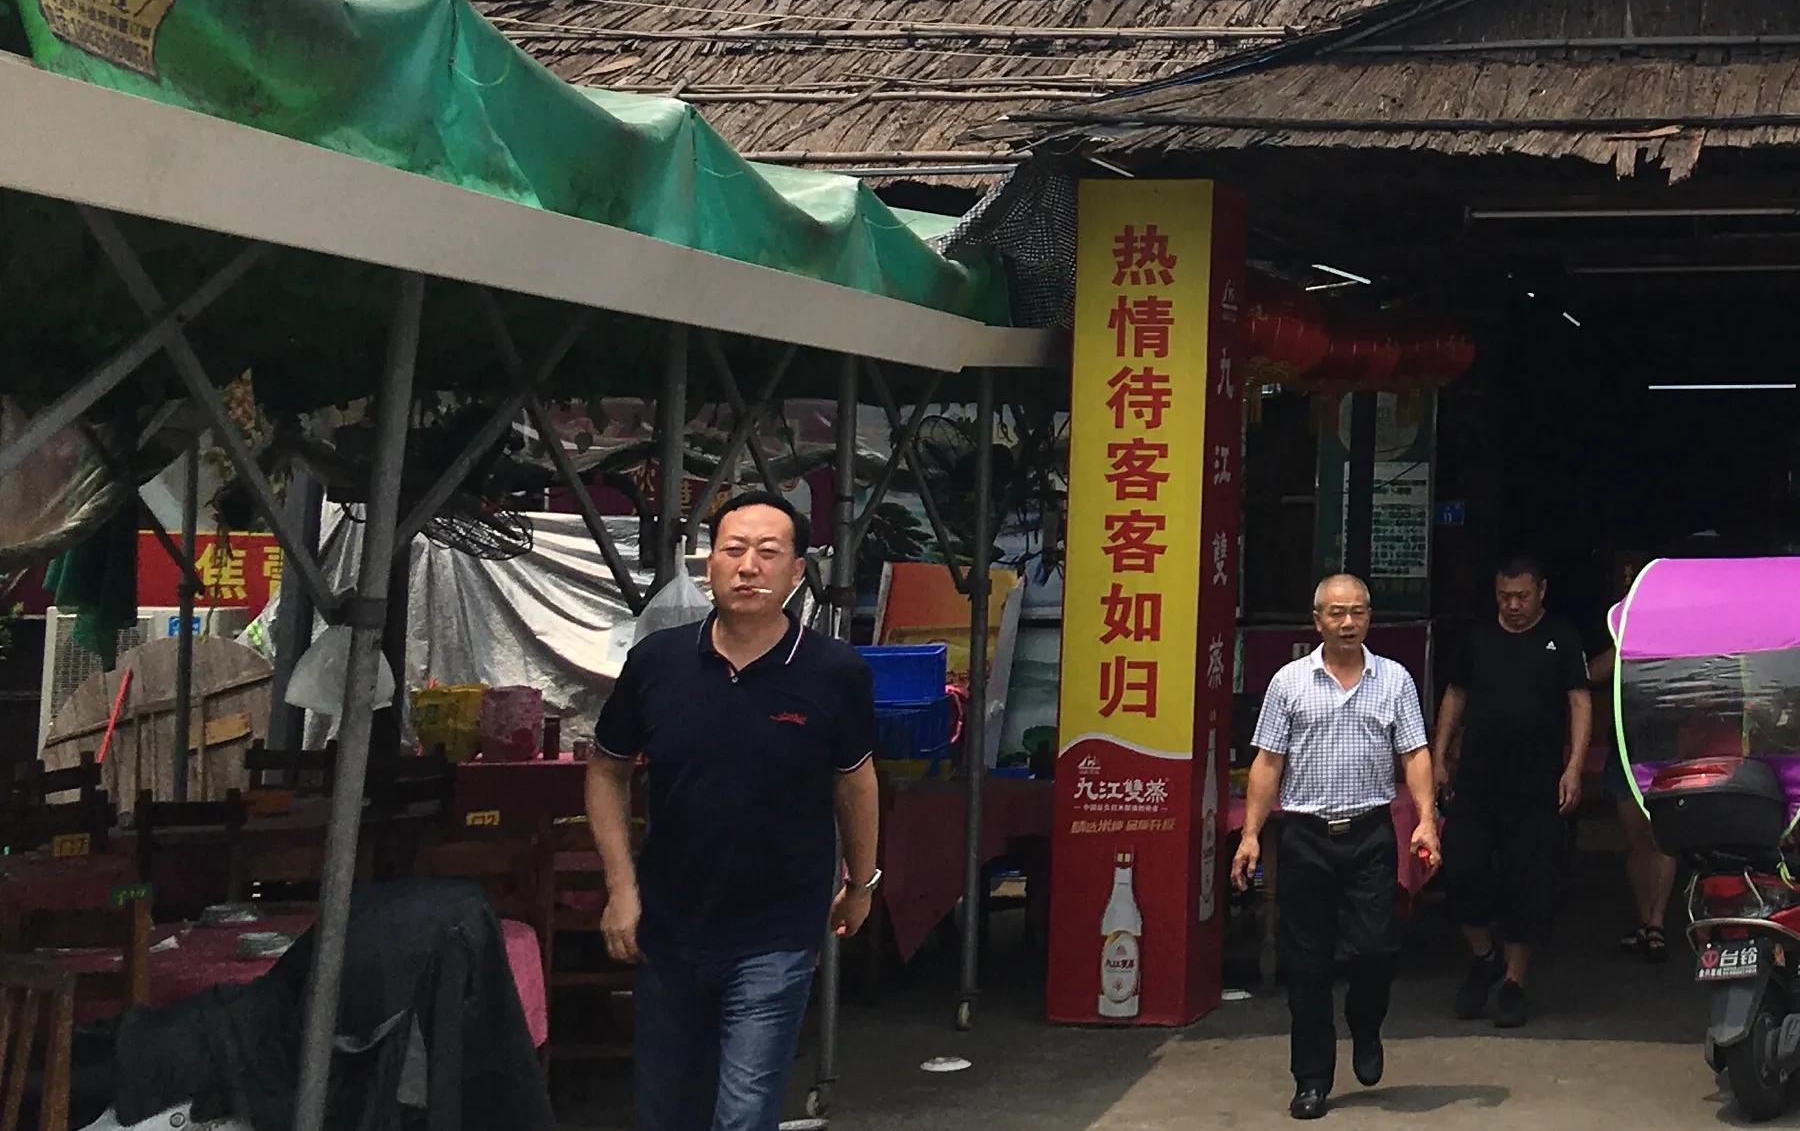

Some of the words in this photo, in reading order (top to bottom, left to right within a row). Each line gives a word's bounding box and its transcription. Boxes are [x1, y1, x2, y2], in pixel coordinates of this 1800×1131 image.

[1099, 224, 1178, 719] 热情待客客如归
